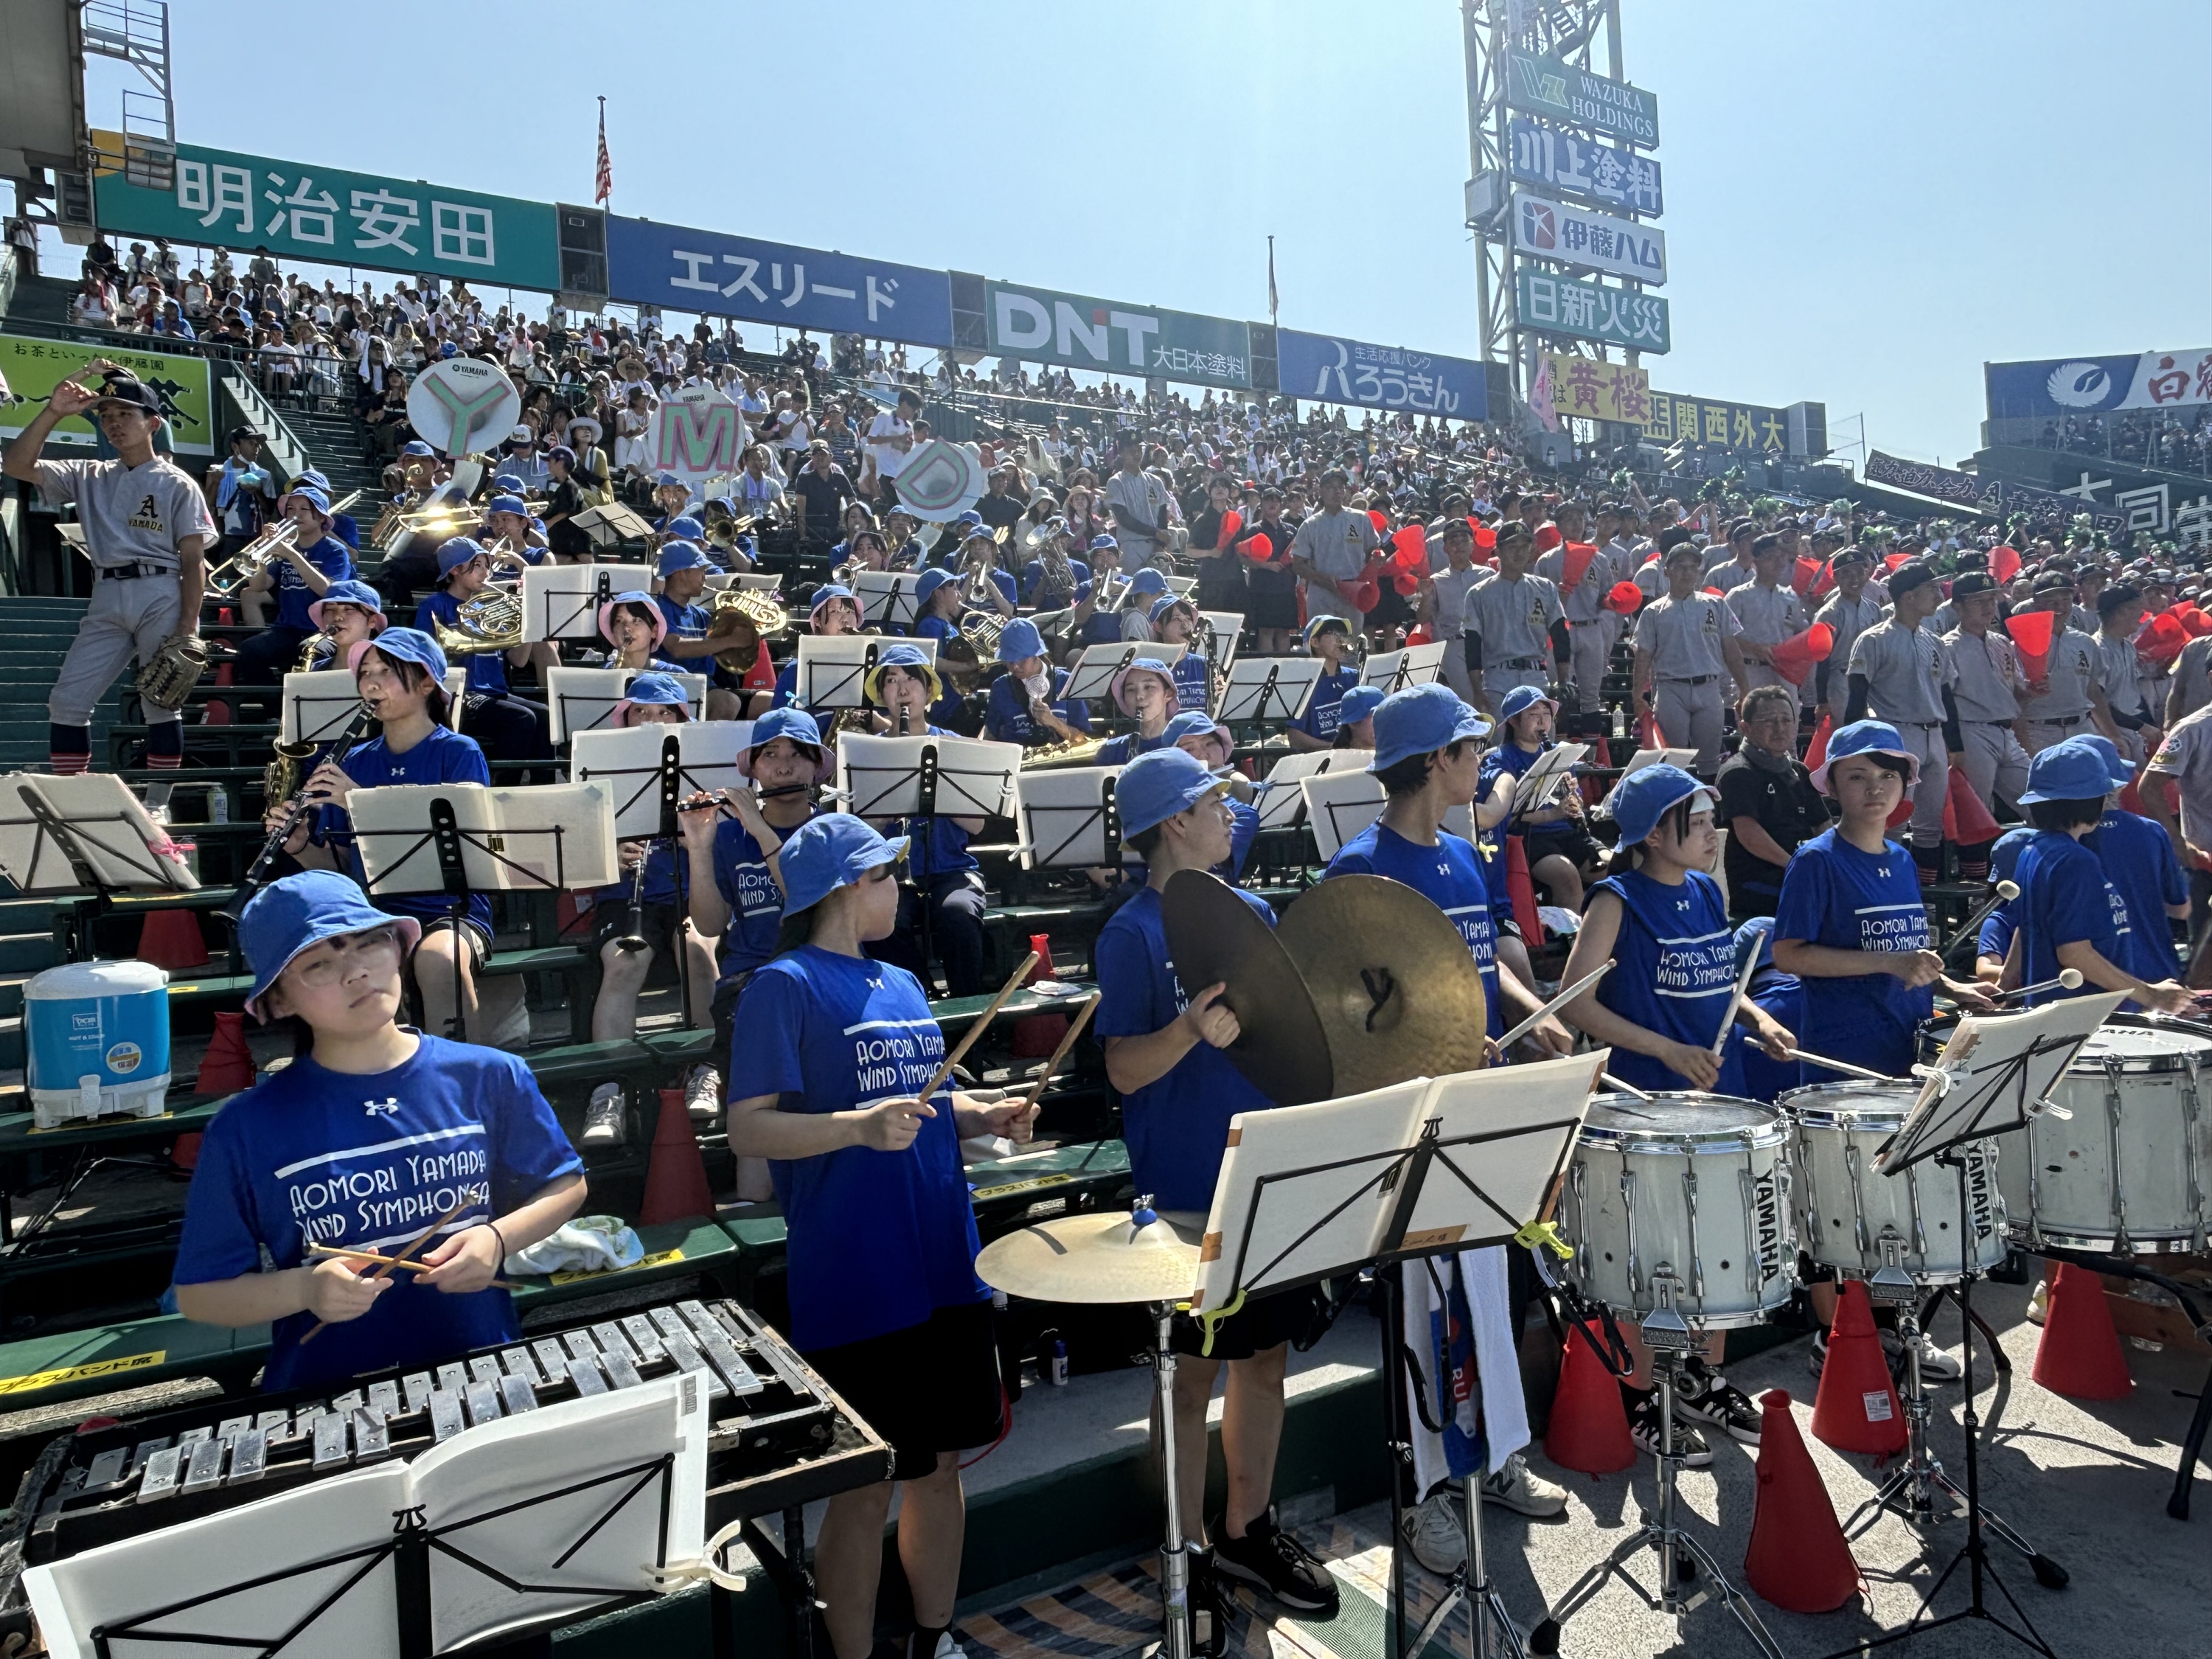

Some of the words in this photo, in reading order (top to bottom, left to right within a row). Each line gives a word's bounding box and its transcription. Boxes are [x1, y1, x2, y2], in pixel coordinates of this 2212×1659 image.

[1571, 95, 1654, 138] HOLDINGS
[1580, 74, 1644, 113] WAZUKA
[1519, 129, 1660, 209] 川上塗料
[177, 159, 495, 267] 明治安田
[1561, 216, 1663, 270] 伊藤ハム
[669, 249, 900, 322] エスリード
[1528, 276, 1663, 344] 日新火災
[994, 291, 1159, 367] DNT
[1151, 345, 1247, 381] 大日本塗料
[1354, 344, 1431, 370] 生活応援バンク
[422, 372, 512, 460] Y
[1355, 366, 1460, 414] ろうきん
[1565, 361, 1649, 422] 黄桜
[655, 402, 740, 473] M
[1674, 400, 1785, 451] 関西外大
[136, 494, 159, 519] A
[738, 889, 765, 907] WIND
[1860, 937, 1893, 952] WIND
[856, 1038, 915, 1066] AOMORI
[857, 1066, 897, 1092] WIND
[290, 1166, 398, 1217] AOMORI
[406, 1150, 487, 1186] YAMADA
[1968, 1140, 1992, 1240] YAMAHA
[1756, 1167, 1779, 1283] YAMAHA
